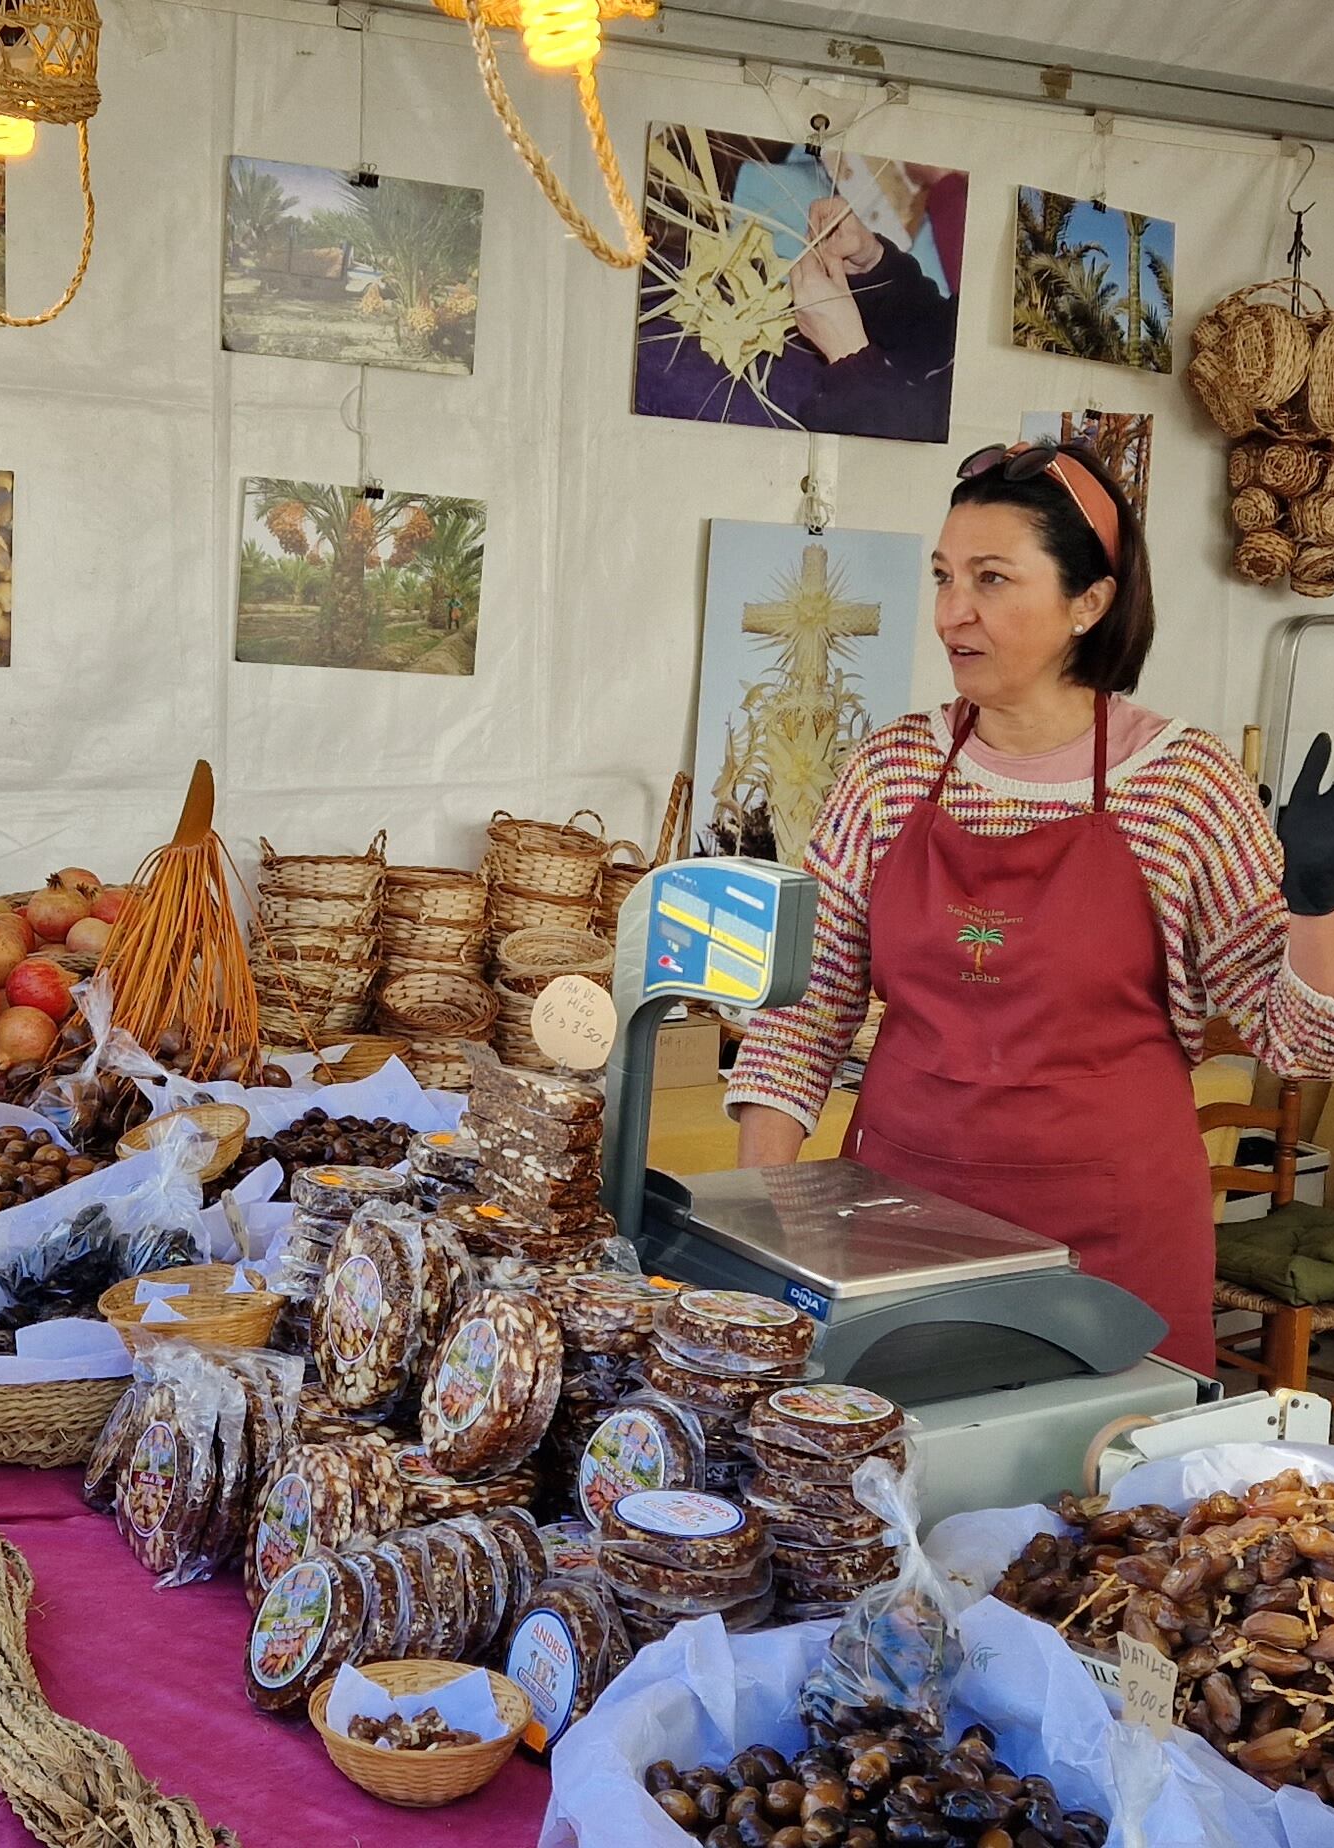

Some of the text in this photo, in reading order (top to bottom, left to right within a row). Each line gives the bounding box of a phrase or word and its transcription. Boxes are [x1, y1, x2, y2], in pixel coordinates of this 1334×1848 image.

[558, 976, 598, 1004] PAN DE
[960, 971, 1000, 984] Elche
[790, 1287, 820, 1311] DINA
[532, 1621, 569, 1665] ANDRES
[1121, 1640, 1174, 1682] DATILES
